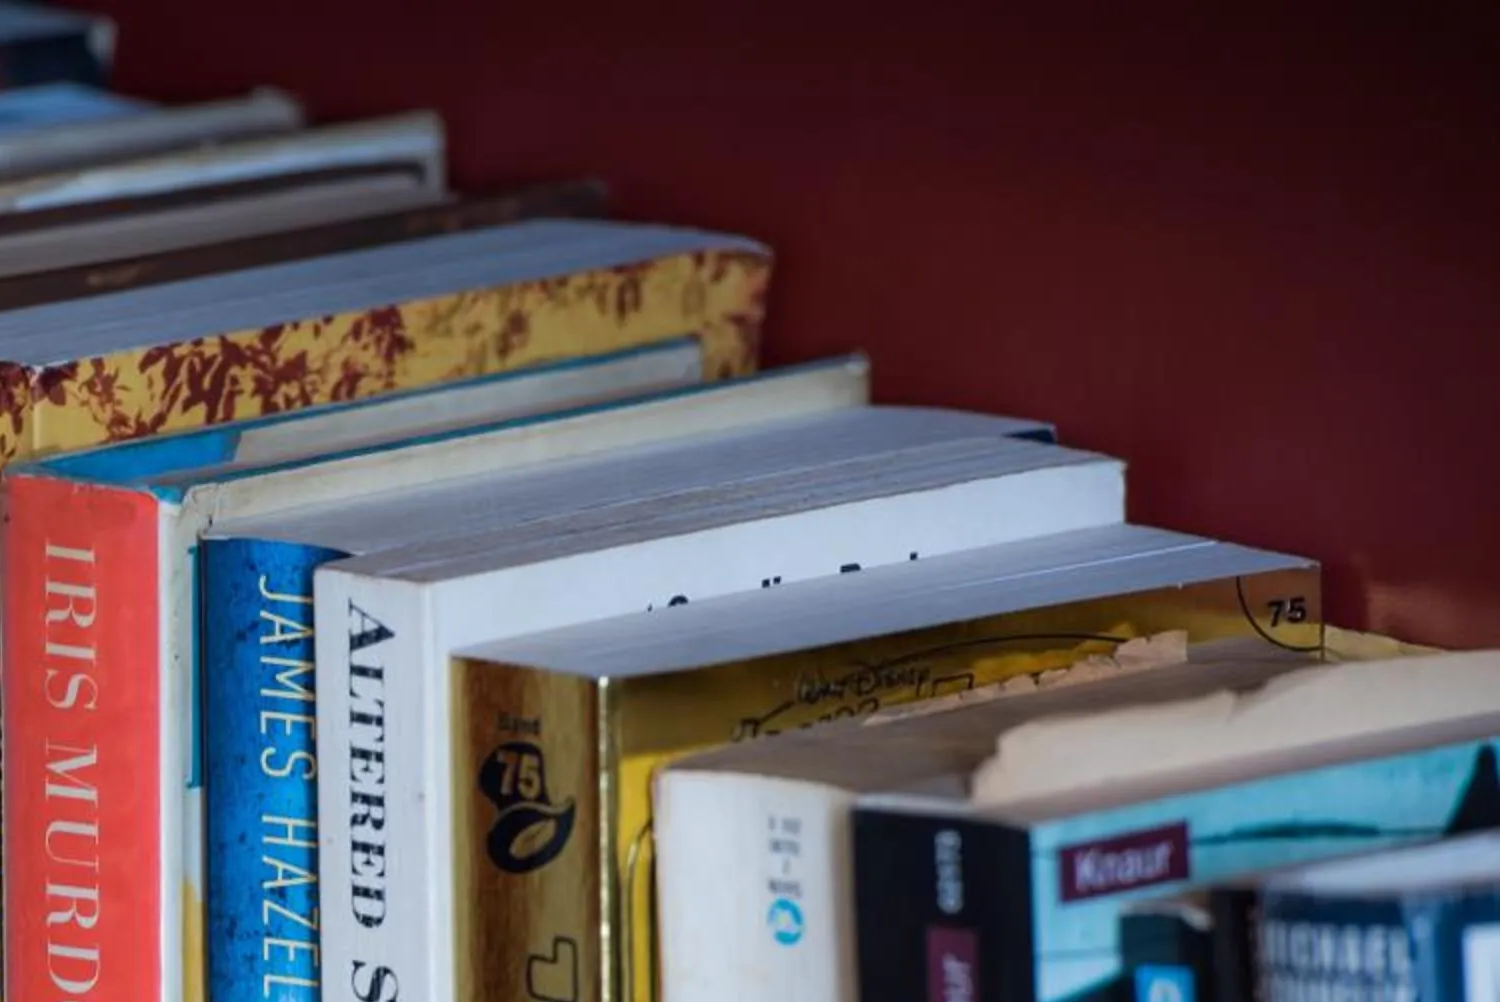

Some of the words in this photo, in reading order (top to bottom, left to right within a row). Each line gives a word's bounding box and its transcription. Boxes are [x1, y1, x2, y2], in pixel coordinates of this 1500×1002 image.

[43, 541, 98, 712] IRIS
[257, 574, 319, 779] JAMES
[1265, 597, 1308, 630] 75
[347, 597, 397, 930] ALTERED
[497, 747, 543, 802] 75
[260, 814, 321, 1000] HAZEL
[1071, 839, 1176, 889] Knaur
